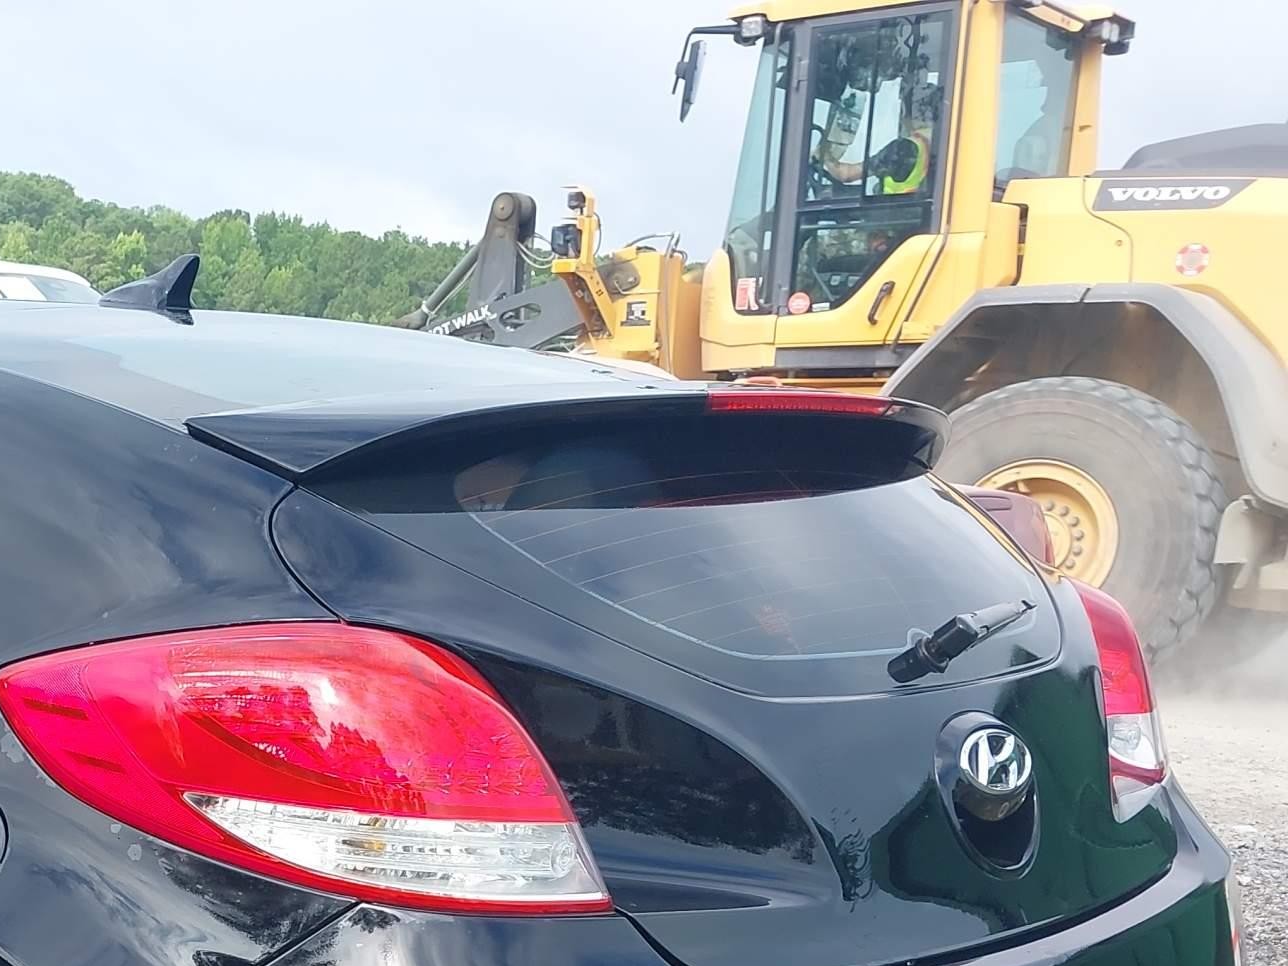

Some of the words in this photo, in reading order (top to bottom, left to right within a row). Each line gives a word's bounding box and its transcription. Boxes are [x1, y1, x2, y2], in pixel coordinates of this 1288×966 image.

[1107, 186, 1231, 201] VOLVO
[428, 321, 451, 335] OT
[452, 304, 492, 329] WALK
